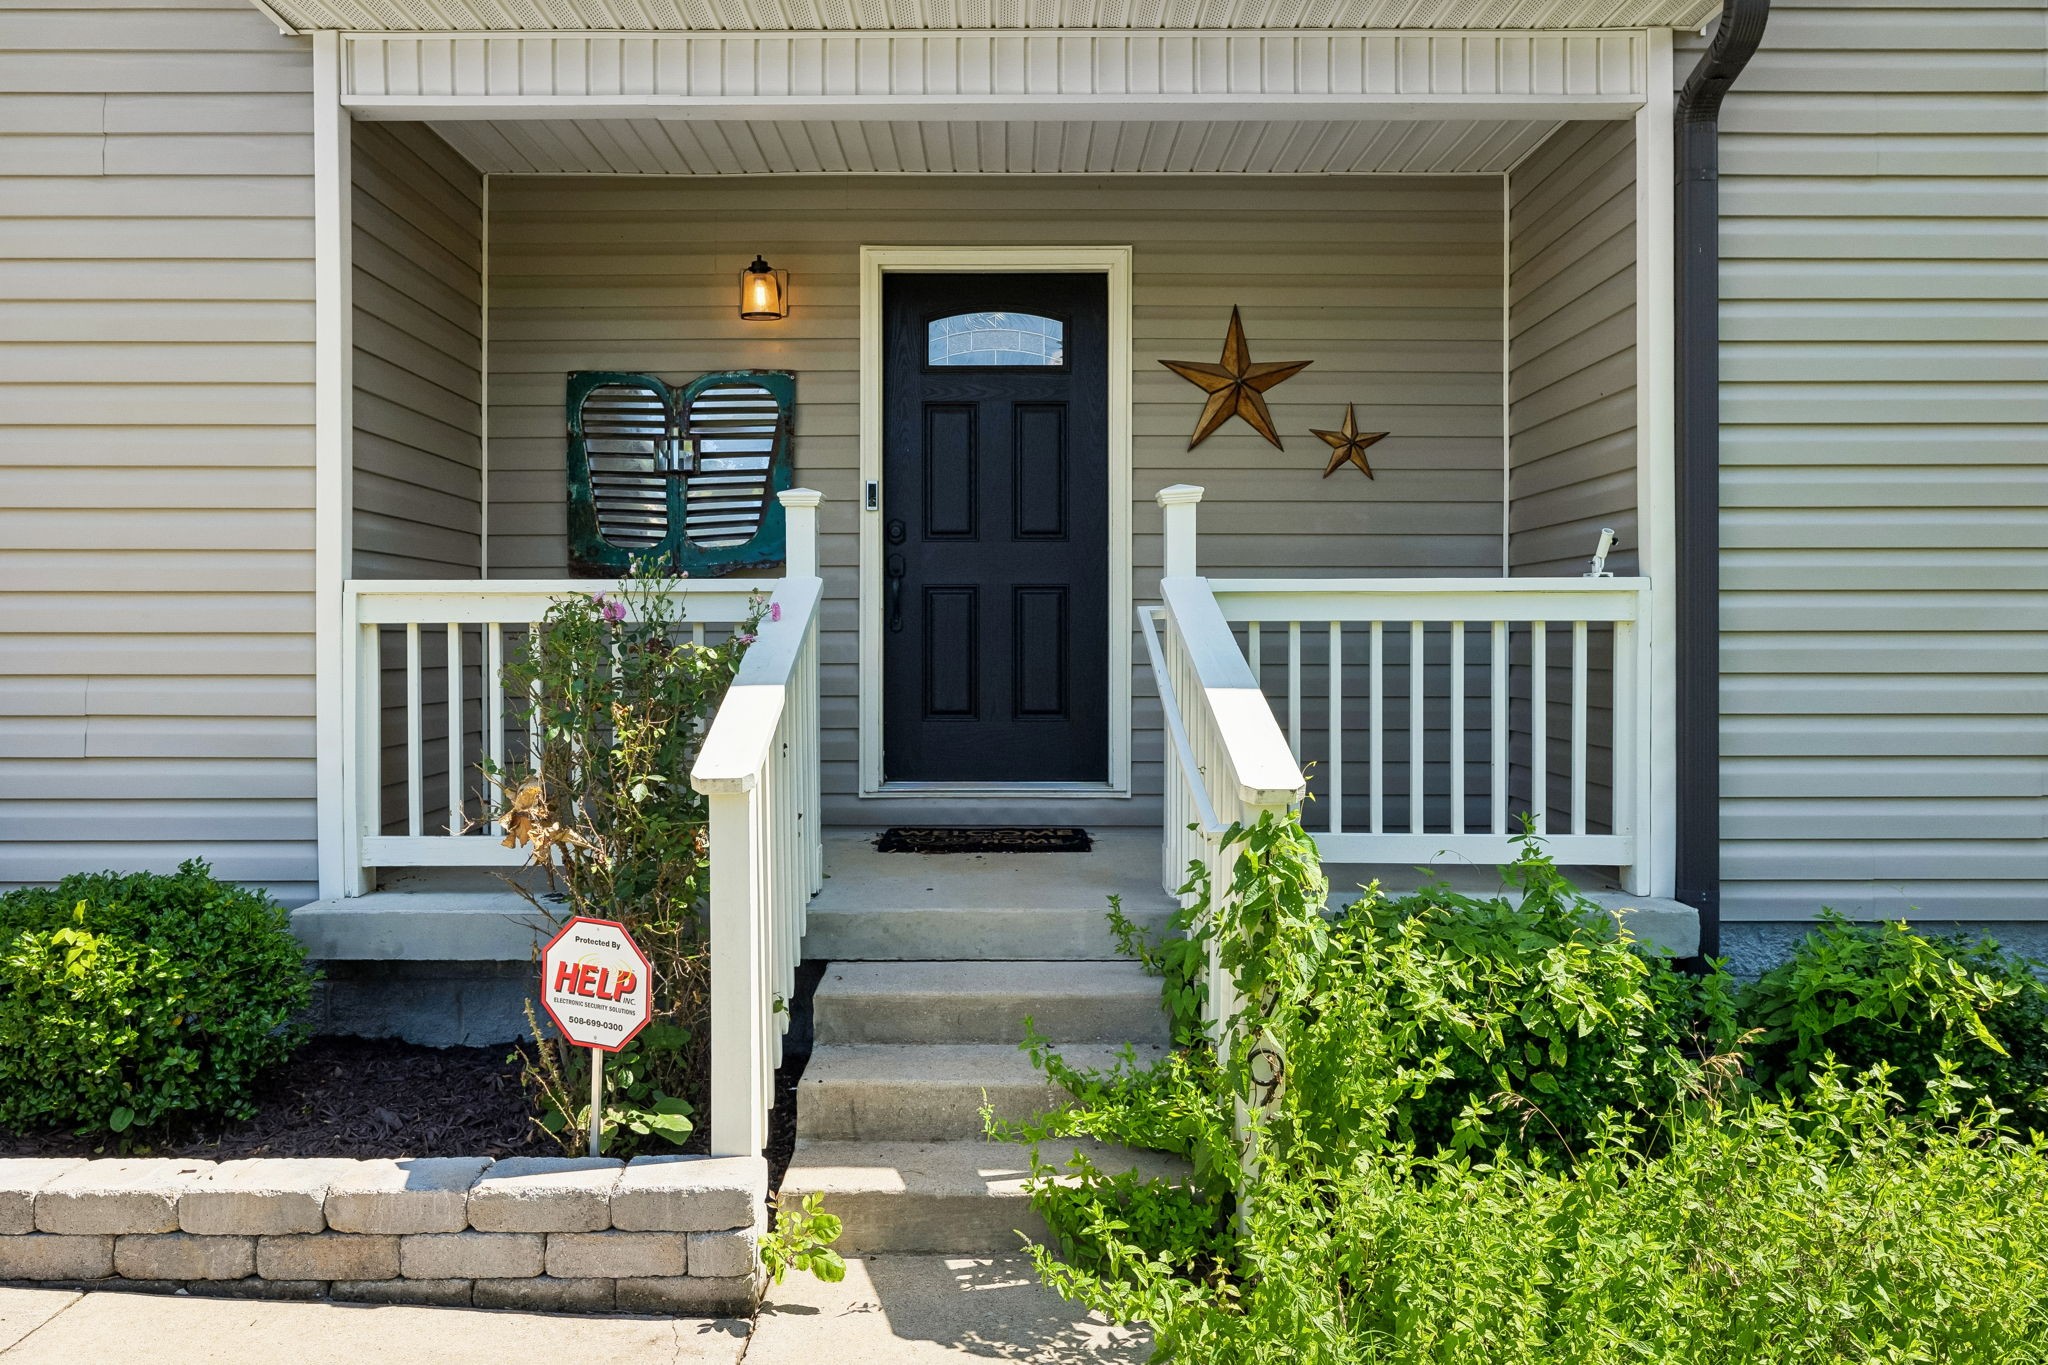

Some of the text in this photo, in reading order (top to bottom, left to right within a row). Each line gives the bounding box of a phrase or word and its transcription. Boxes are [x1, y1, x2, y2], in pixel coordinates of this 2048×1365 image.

[575, 935, 620, 950] Protected By
[553, 960, 637, 1002] HELP
[554, 997, 636, 1016] ELECTRONIC SECURITY SOLUTIONS
[623, 997, 636, 1005] INC.
[568, 1016, 623, 1031] 508-699-0300
